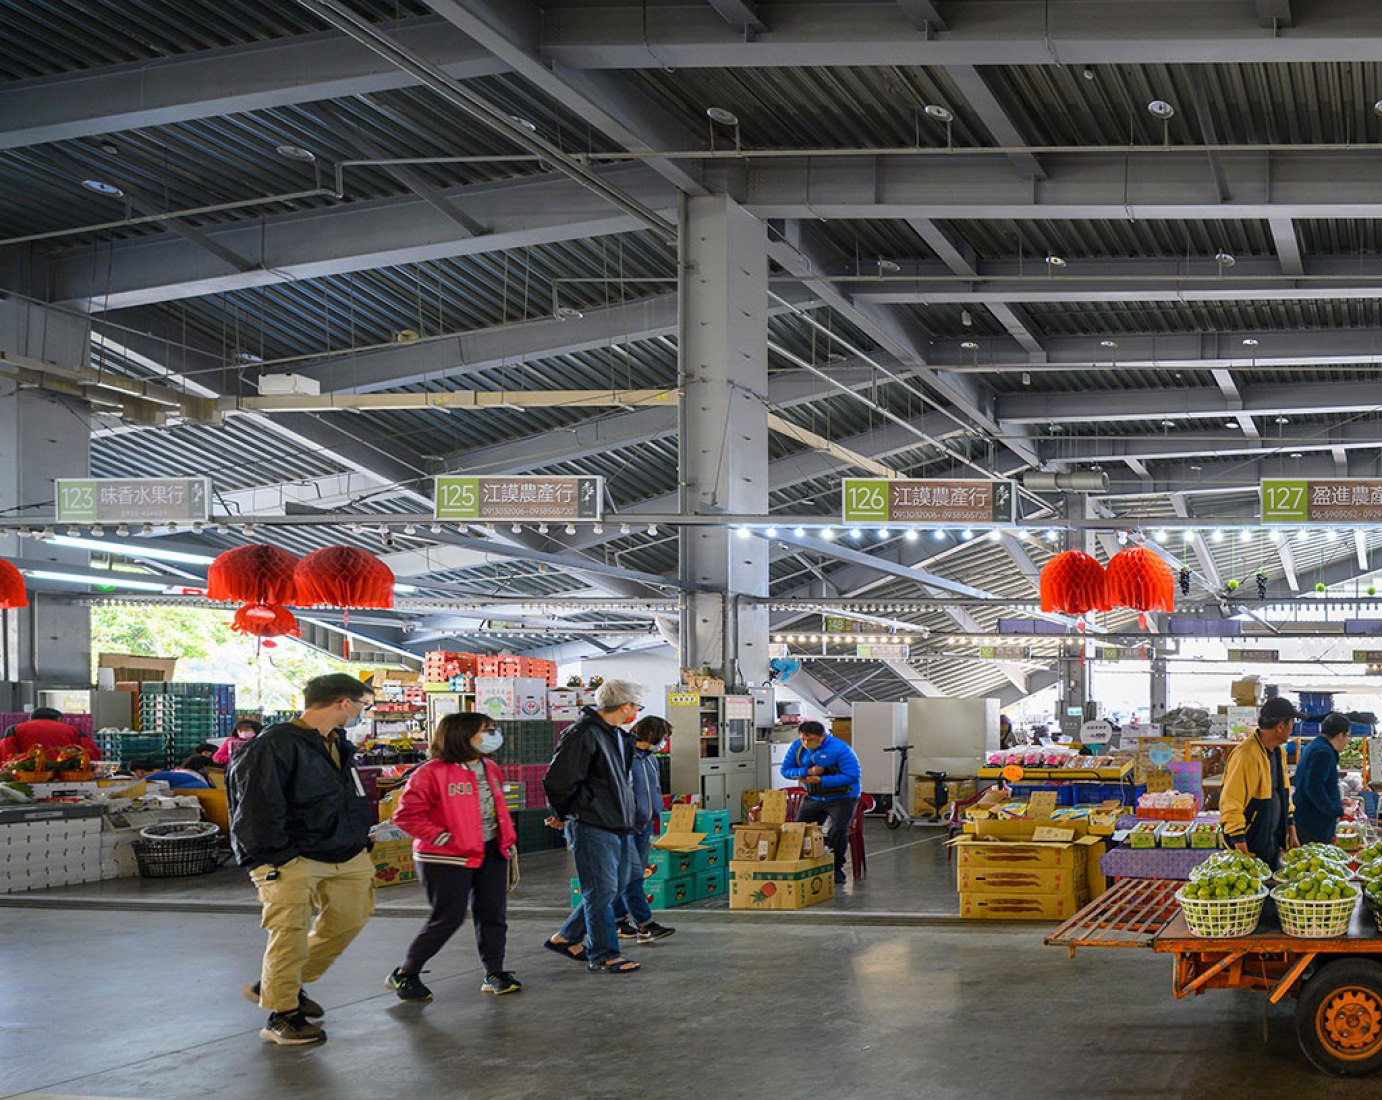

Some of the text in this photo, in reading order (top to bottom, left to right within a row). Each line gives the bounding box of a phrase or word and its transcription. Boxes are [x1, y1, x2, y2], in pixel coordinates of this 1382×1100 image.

[61, 487, 94, 509] 123
[101, 485, 184, 505] 味香水果行
[440, 484, 475, 507] 125
[849, 487, 885, 510] 126
[1266, 486, 1304, 510] 127
